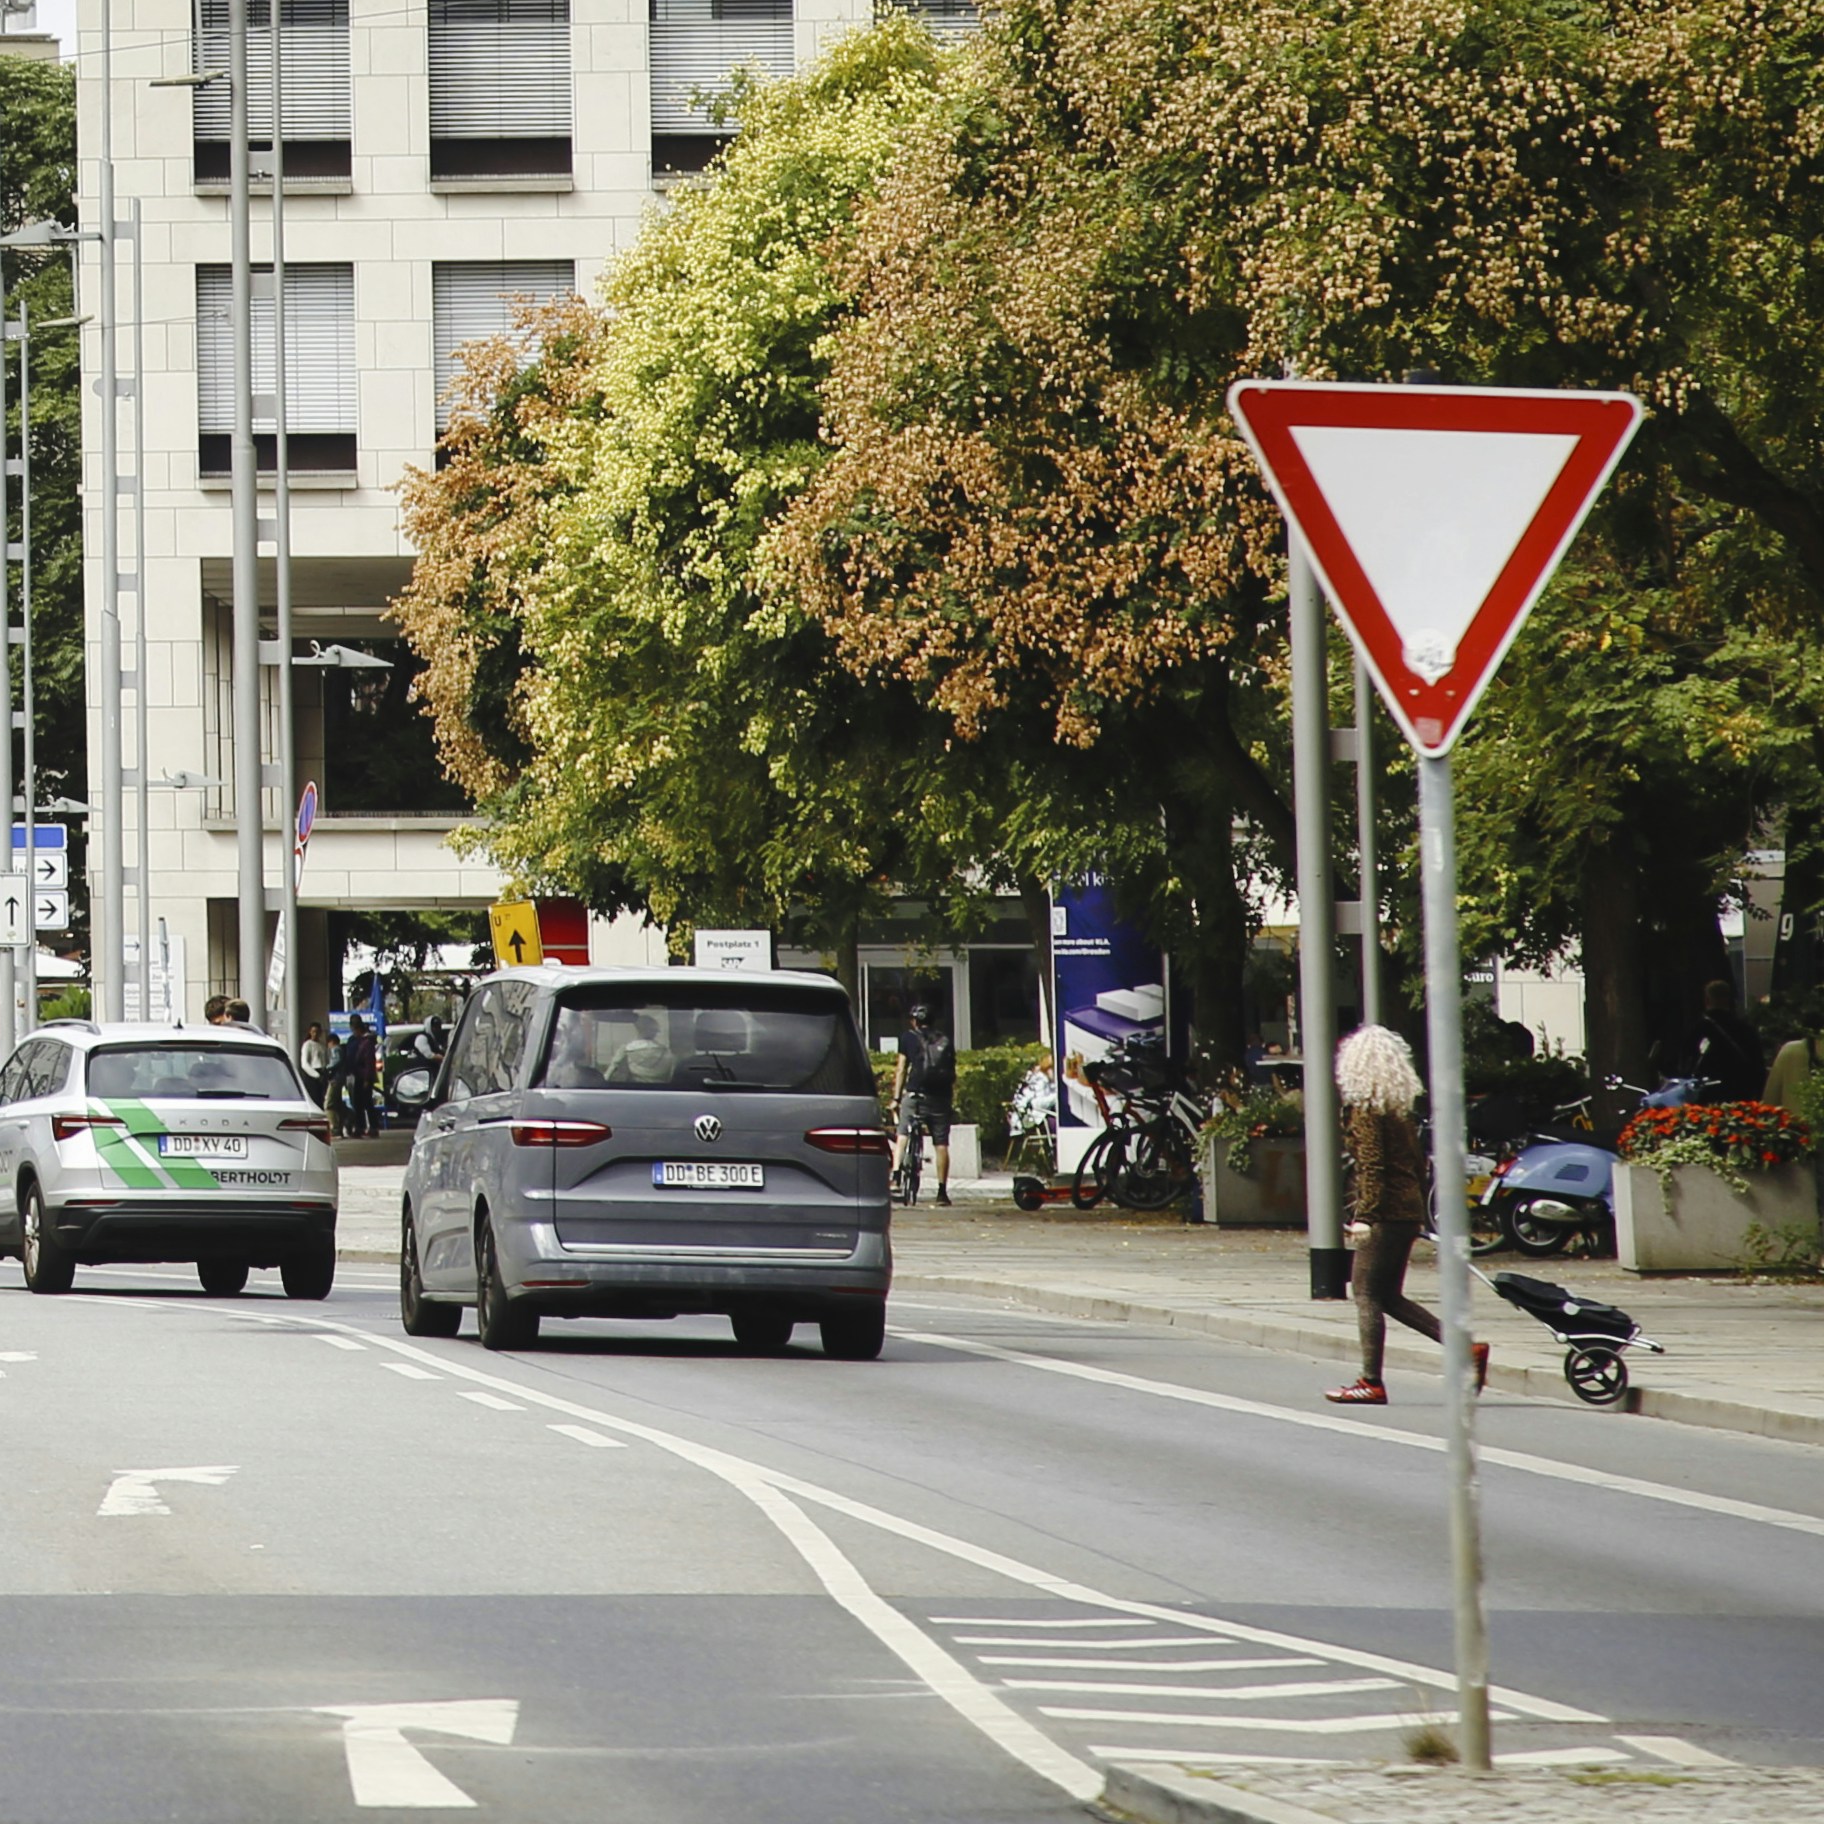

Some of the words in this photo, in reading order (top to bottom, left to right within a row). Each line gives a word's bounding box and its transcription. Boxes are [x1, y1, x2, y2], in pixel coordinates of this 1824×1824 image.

[706, 940, 752, 950] Postplatz
[173, 1137, 192, 1152] DD
[202, 1138, 220, 1152] XY
[223, 1138, 241, 1152] 40
[665, 1164, 685, 1182] DD
[696, 1165, 716, 1182] BE
